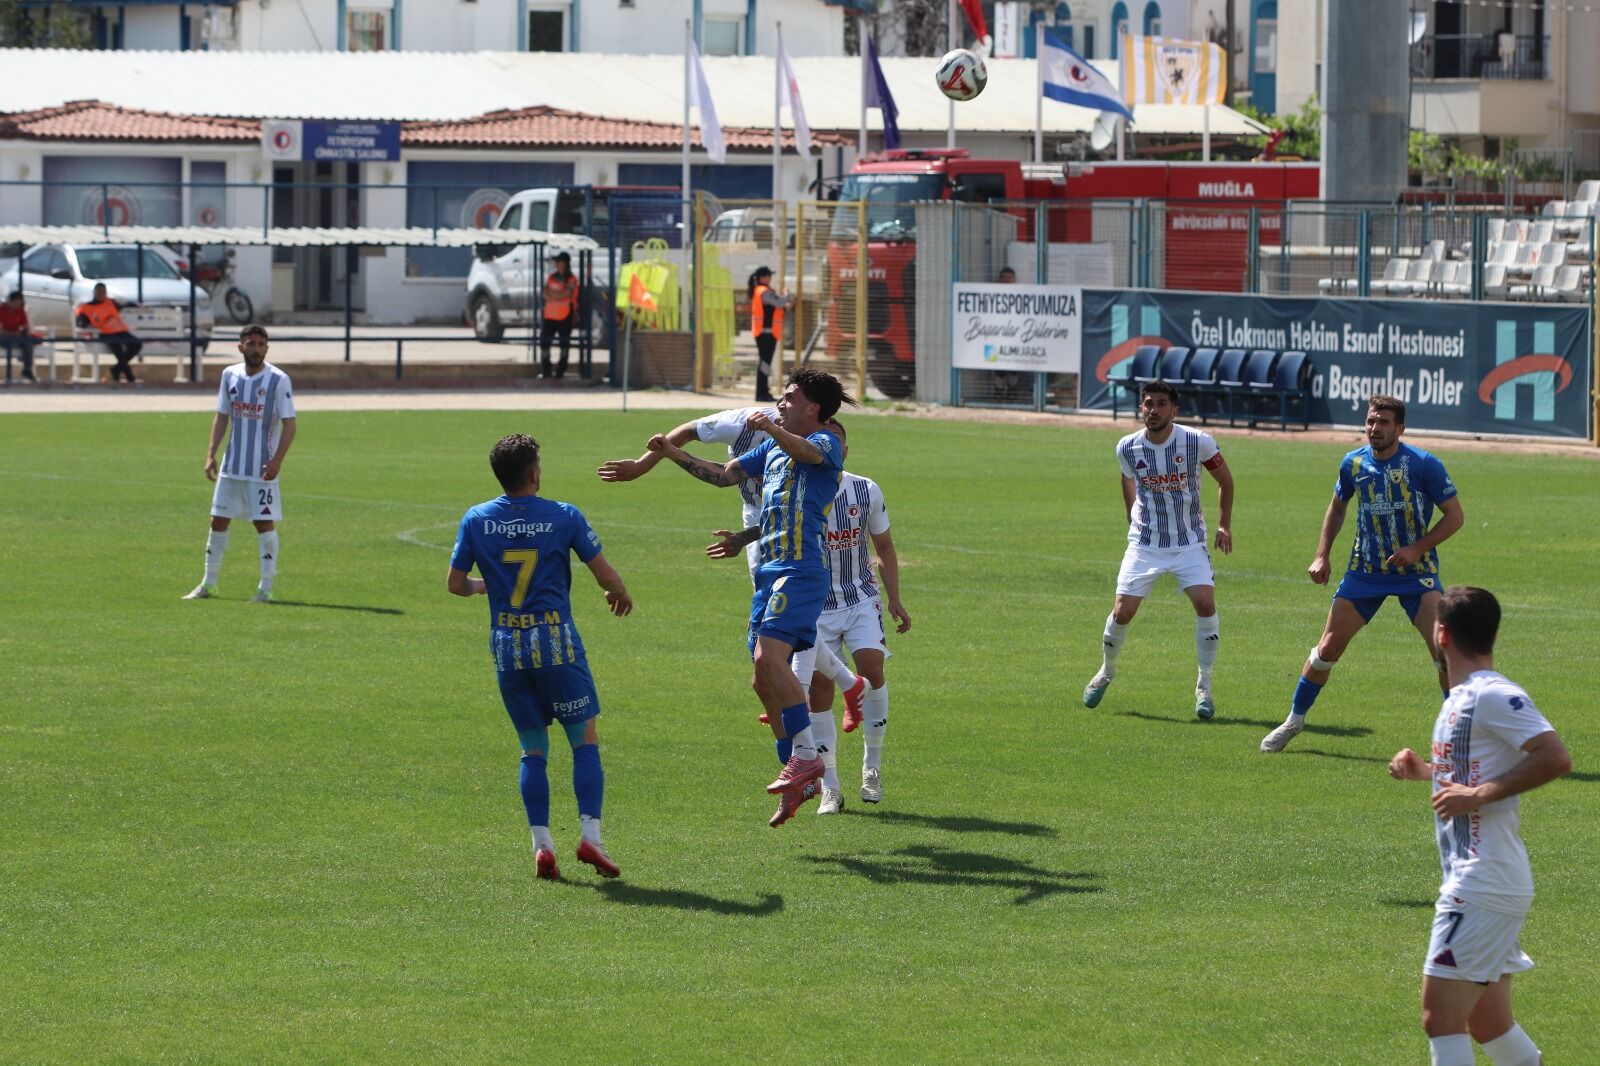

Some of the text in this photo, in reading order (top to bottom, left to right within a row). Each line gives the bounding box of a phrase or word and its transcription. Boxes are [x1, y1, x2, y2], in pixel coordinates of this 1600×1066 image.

[1198, 180, 1255, 197] MUĞLA
[1191, 309, 1465, 358] Özel Lokman Hekim Esnaf Hastanesi
[1328, 364, 1414, 411] Başarılar
[1418, 367, 1464, 406] Diler
[1140, 472, 1188, 486] ESNAF
[258, 488, 273, 506] 26
[503, 549, 538, 609] 7
[552, 695, 590, 713] Feyzan
[1445, 911, 1465, 945] 7
